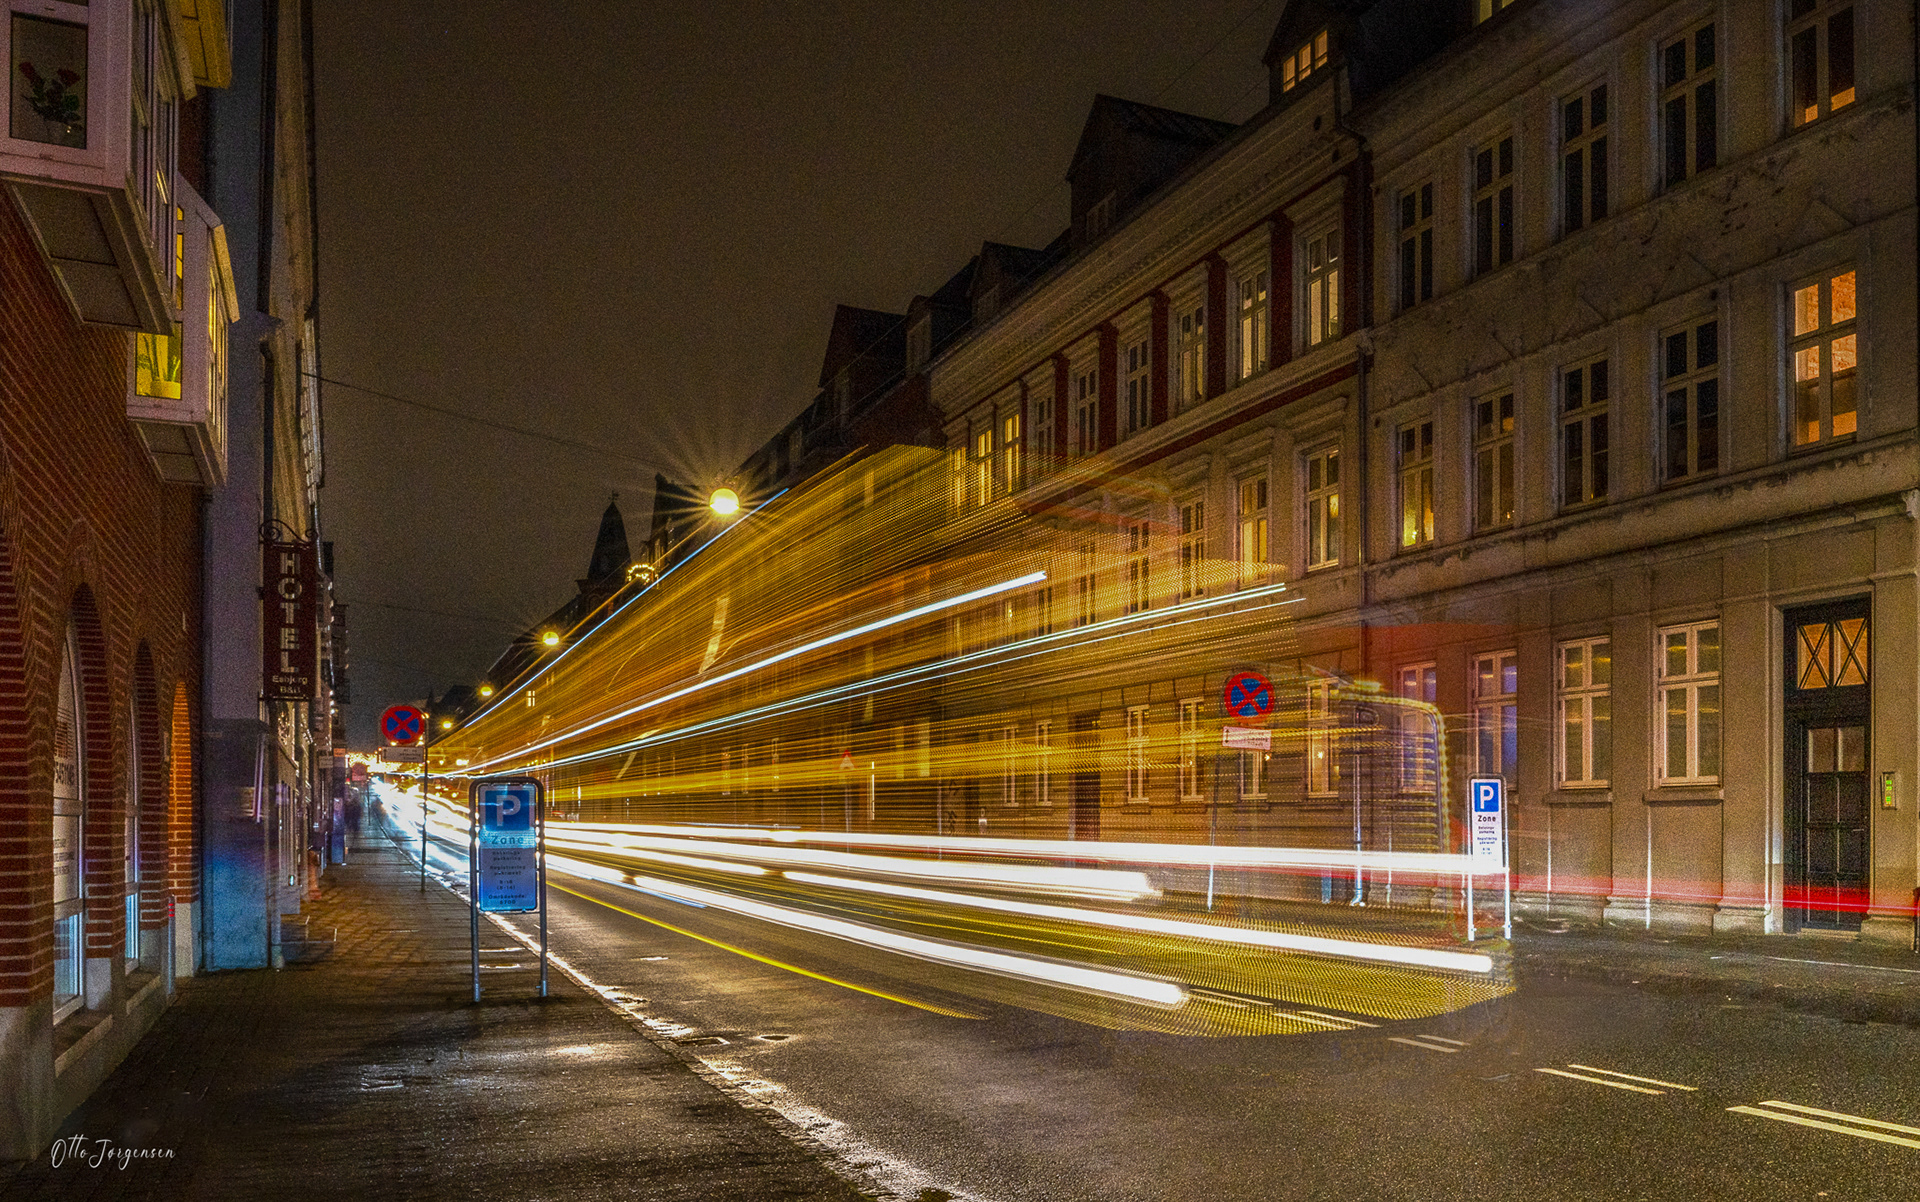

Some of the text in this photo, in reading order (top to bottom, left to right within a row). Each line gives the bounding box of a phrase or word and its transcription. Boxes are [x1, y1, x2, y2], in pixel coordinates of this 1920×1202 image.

[278, 552, 302, 673] HOTEL
[497, 795, 521, 826] P
[1480, 785, 1494, 809] P
[491, 836, 524, 844] Zone
